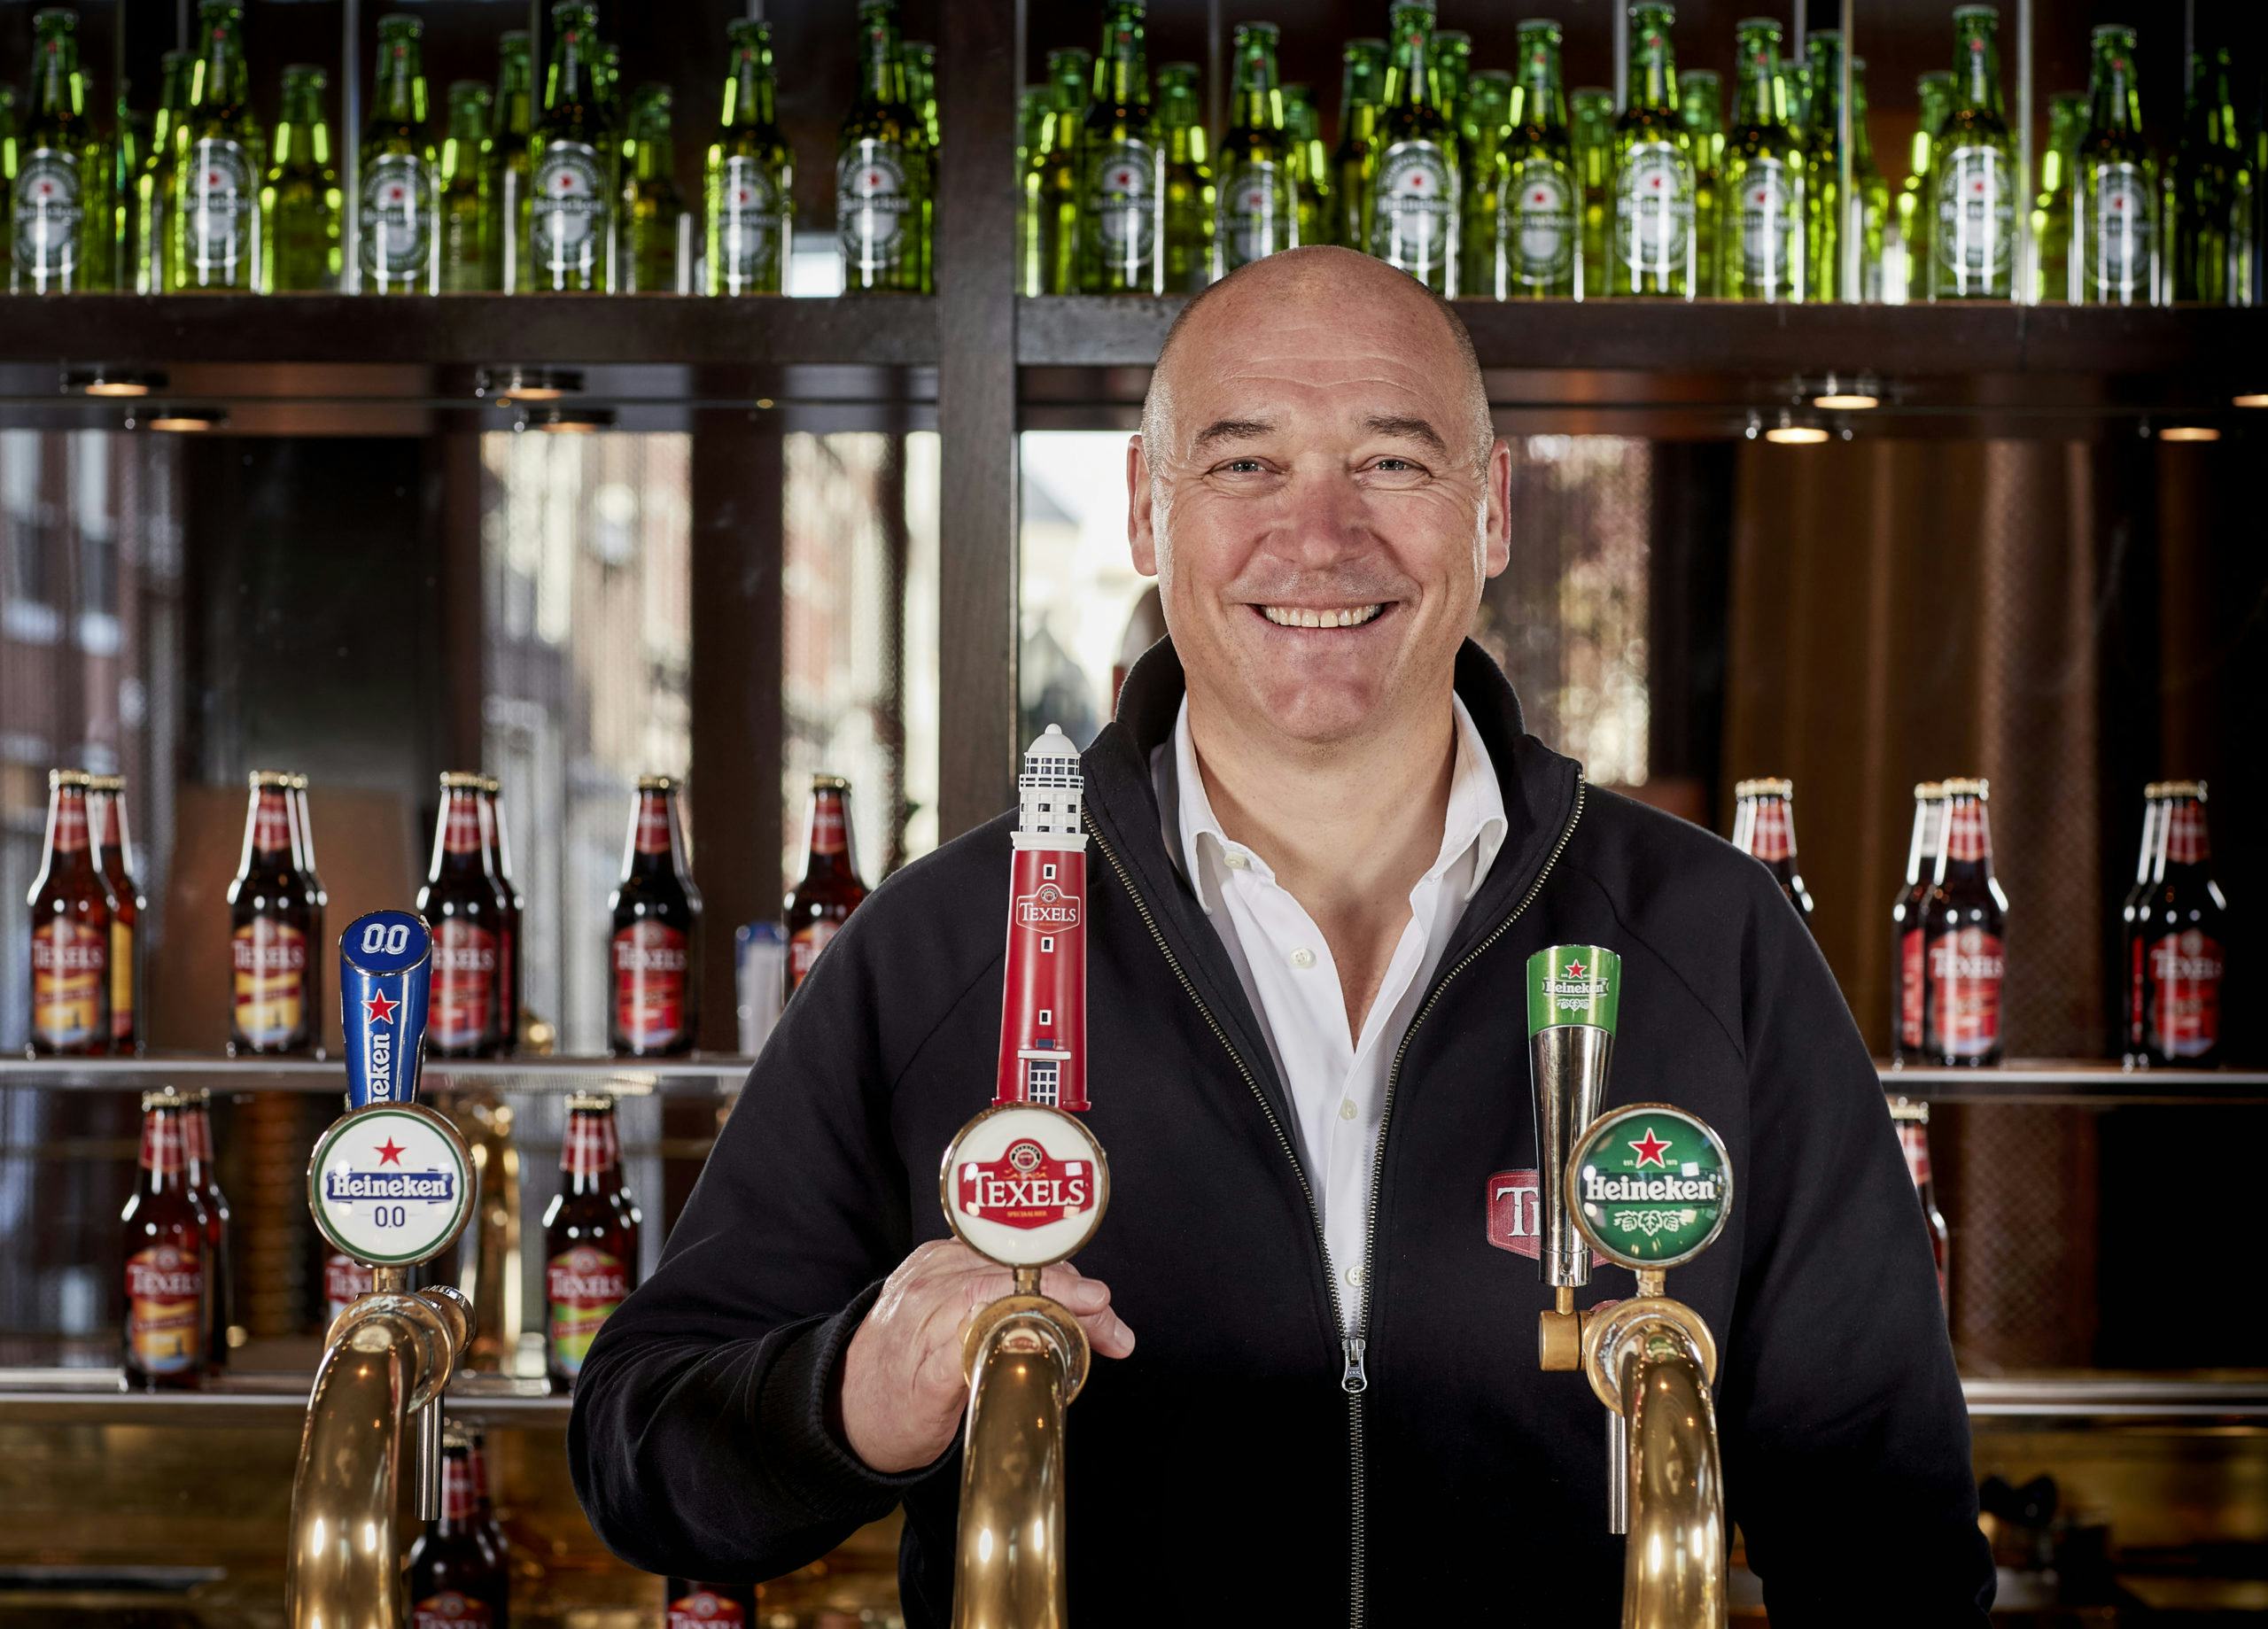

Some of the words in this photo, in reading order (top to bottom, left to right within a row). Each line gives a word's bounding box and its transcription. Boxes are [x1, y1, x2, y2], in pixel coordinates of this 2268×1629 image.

[1020, 903, 1076, 921] TEXELS
[361, 924, 409, 955] 0.0
[1545, 981, 1604, 993] Heineken
[332, 1175, 448, 1198] Heineken
[964, 1171, 1085, 1207] TEXELS
[1586, 1175, 1717, 1200] Heineken
[375, 1206, 406, 1228] 0.0
